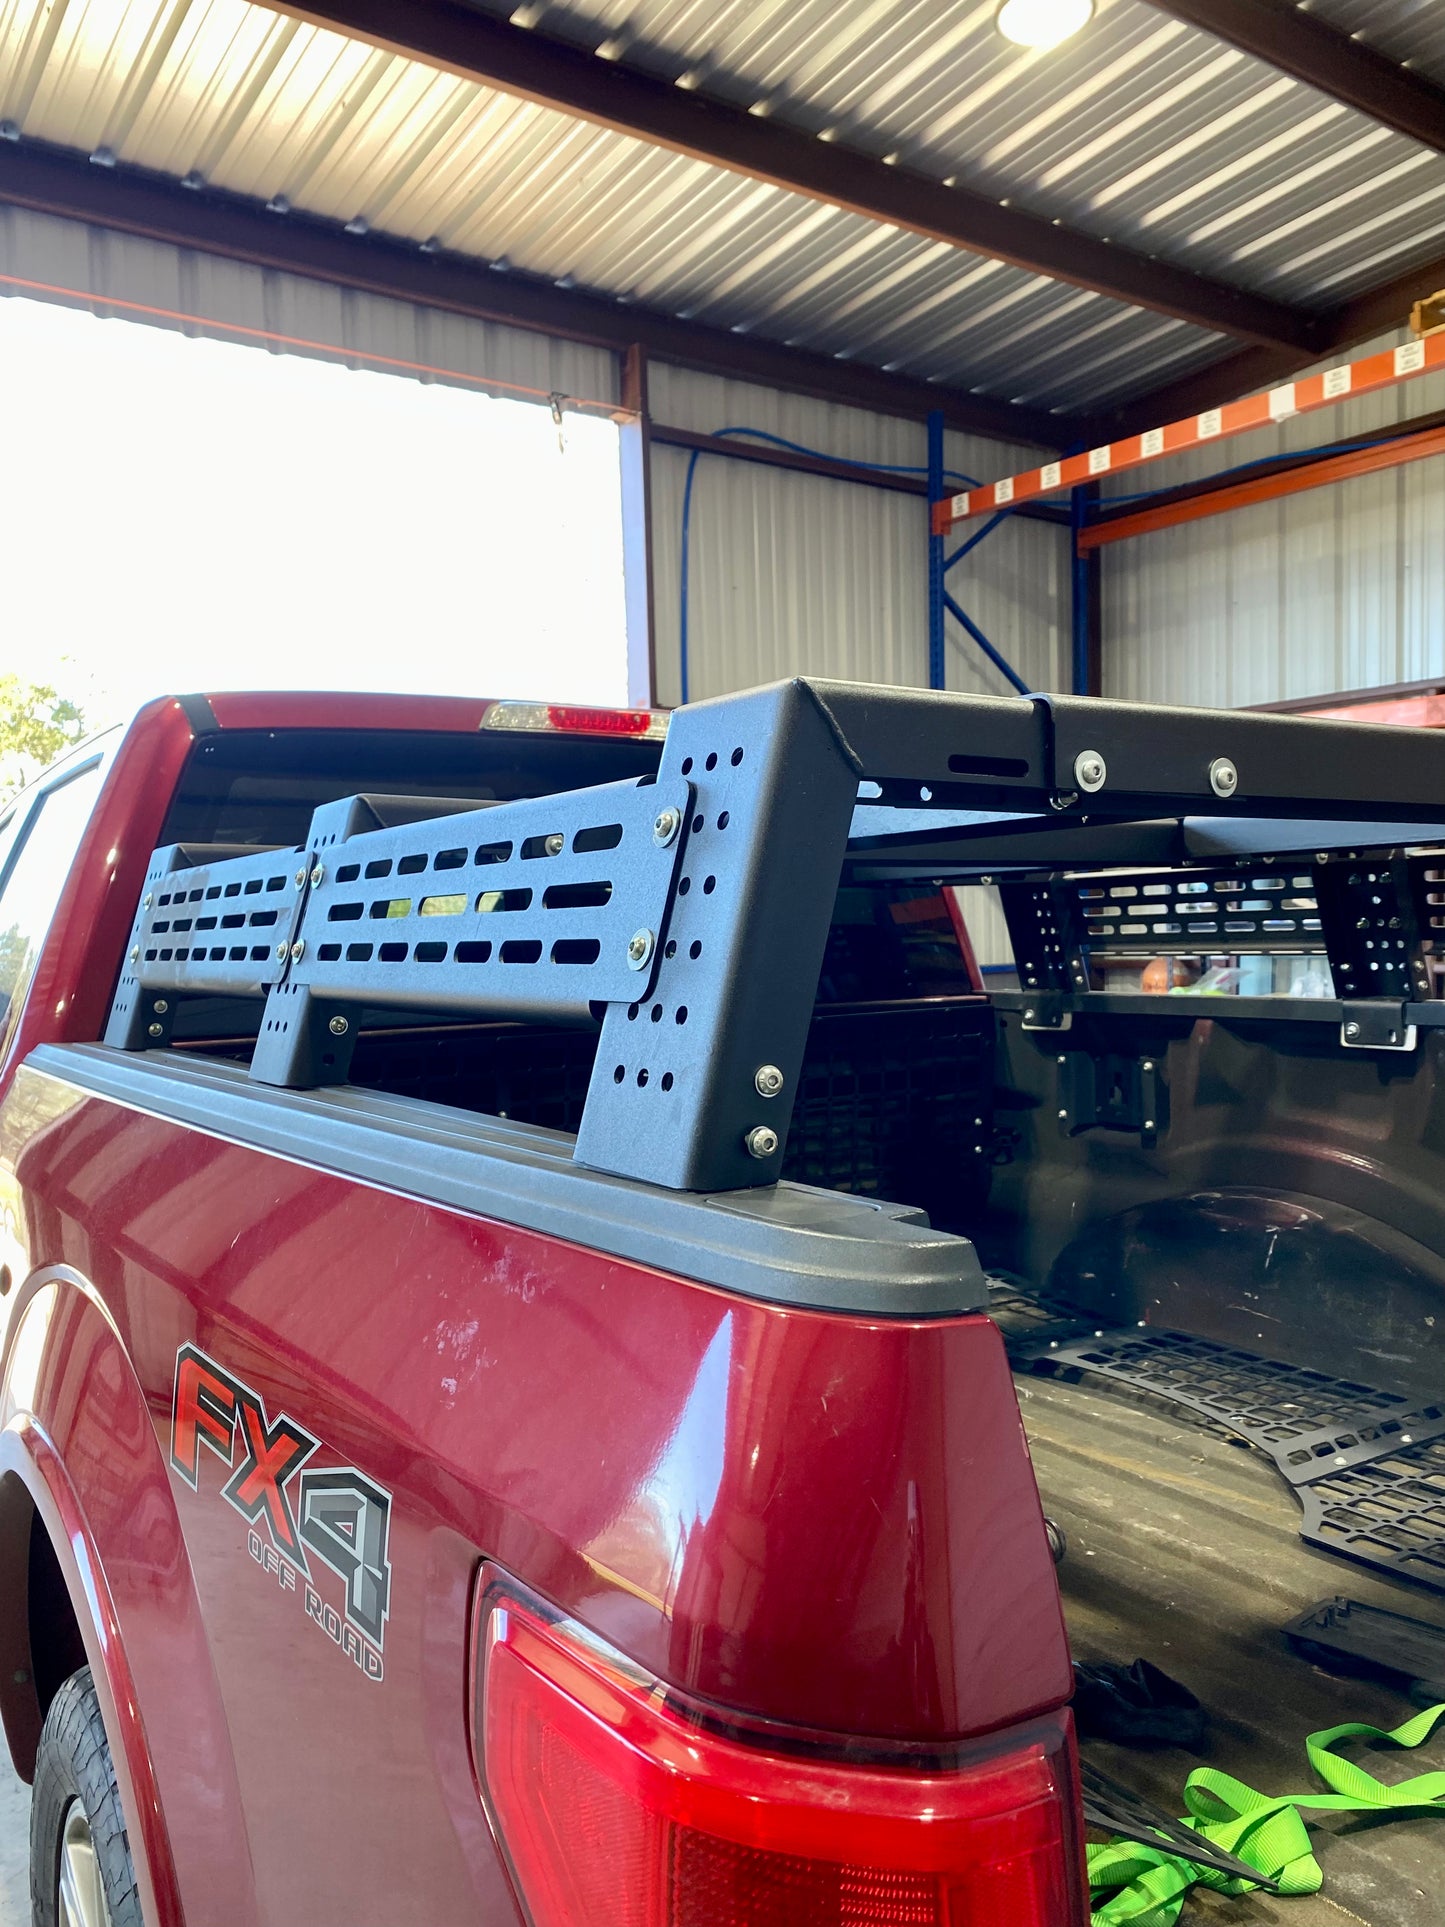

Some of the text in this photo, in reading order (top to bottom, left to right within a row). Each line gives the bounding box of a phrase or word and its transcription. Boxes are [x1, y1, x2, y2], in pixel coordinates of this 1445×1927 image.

[170, 1339, 393, 1653] FX4
[247, 1528, 385, 1682] OFF ROAD
